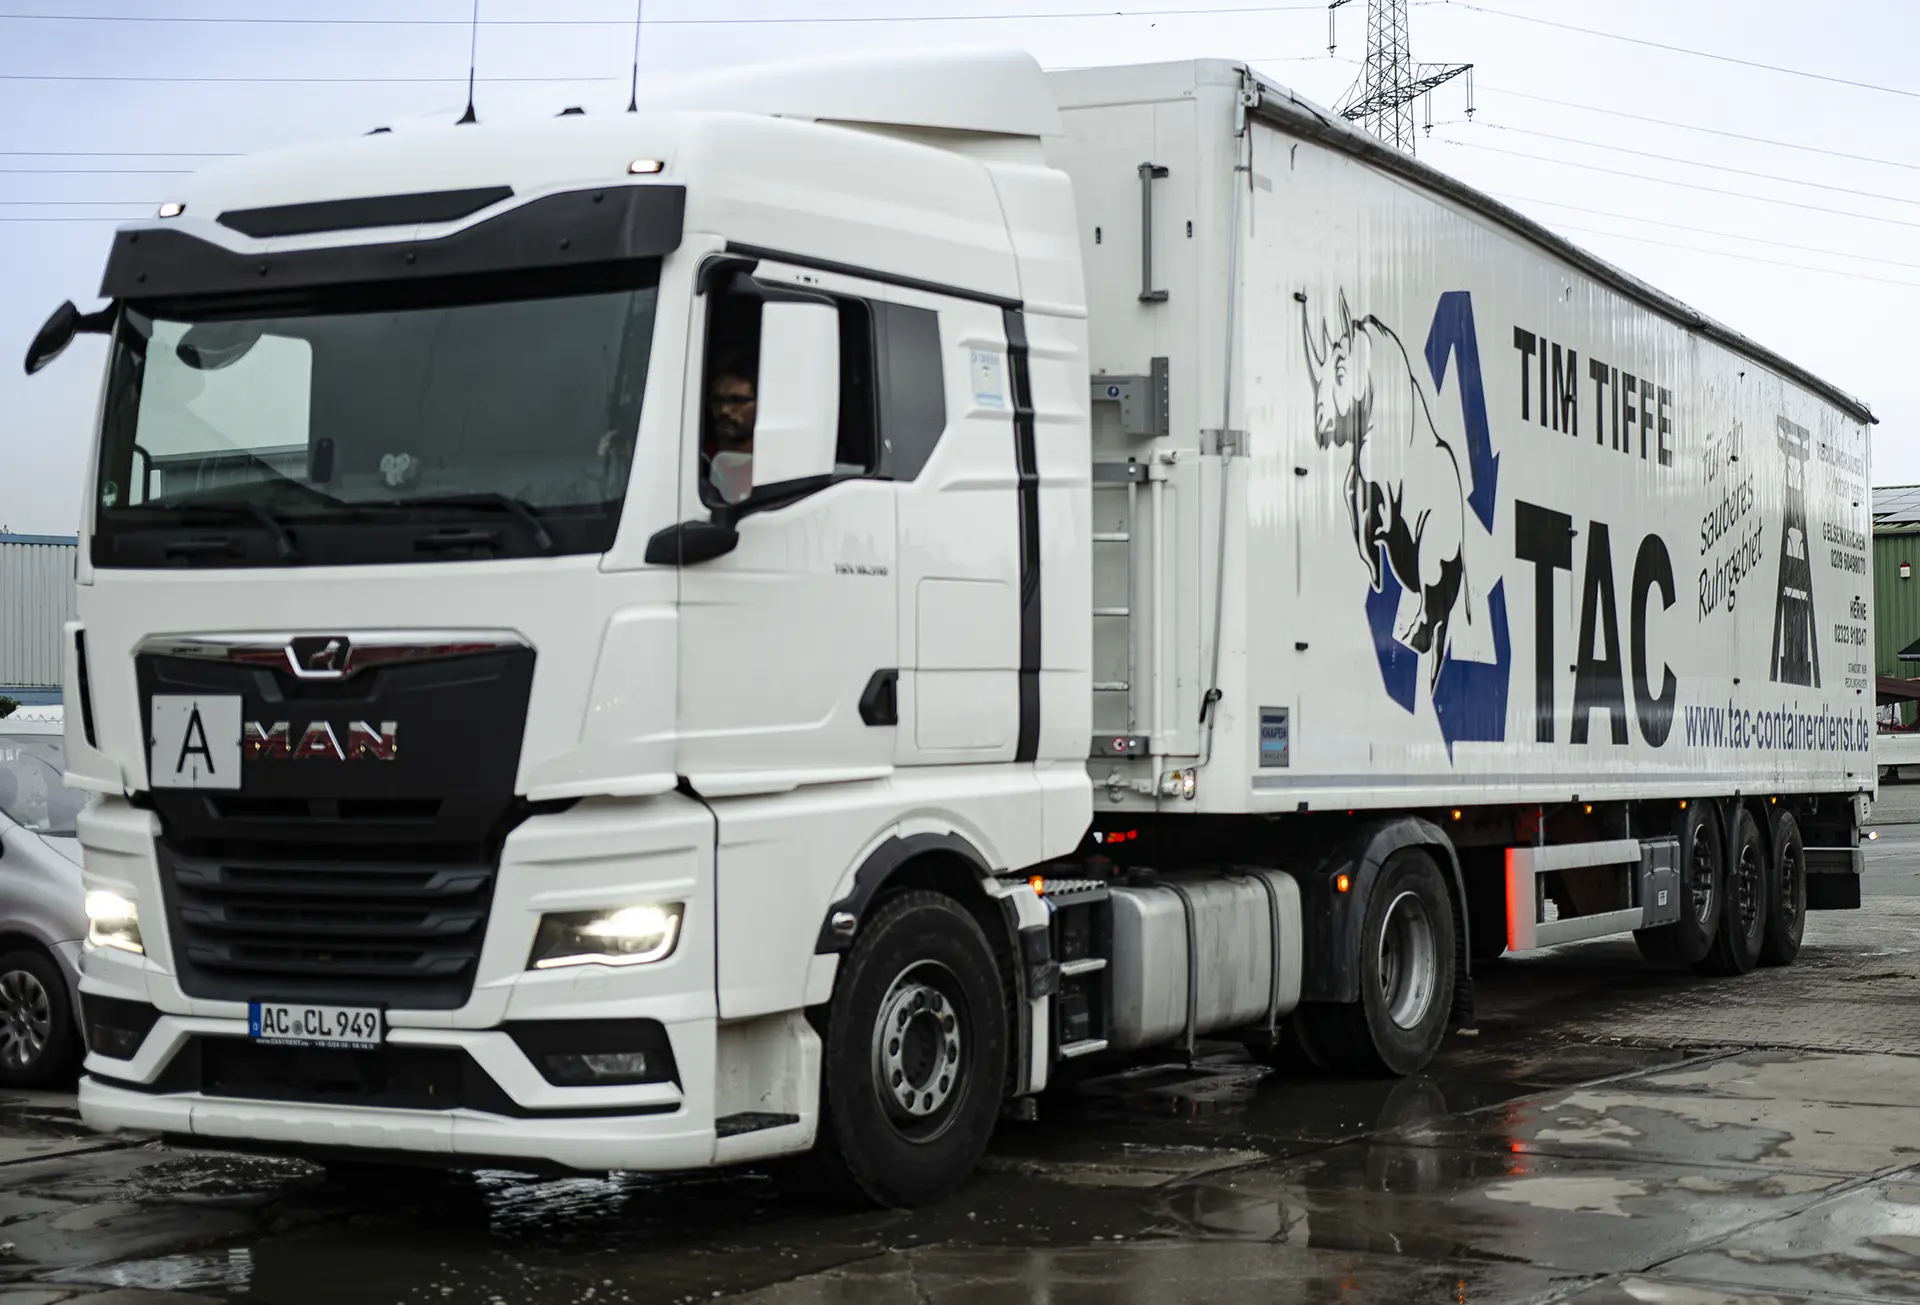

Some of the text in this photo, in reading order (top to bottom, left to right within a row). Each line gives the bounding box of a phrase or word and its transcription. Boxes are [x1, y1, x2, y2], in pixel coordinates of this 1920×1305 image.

[1513, 325, 1673, 467] TIM TIFFE
[1701, 416, 1743, 486] für ein
[1700, 473, 1754, 556] sauberes
[1698, 516, 1763, 624] Ruhrgebiet
[1514, 499, 1678, 748] TAC
[1849, 600, 1867, 621] HERNE
[176, 708, 215, 774] A
[244, 720, 398, 760] MAN
[1684, 697, 1869, 752] www.tac-containerdienst.de
[262, 1007, 376, 1038] AC CL 949
